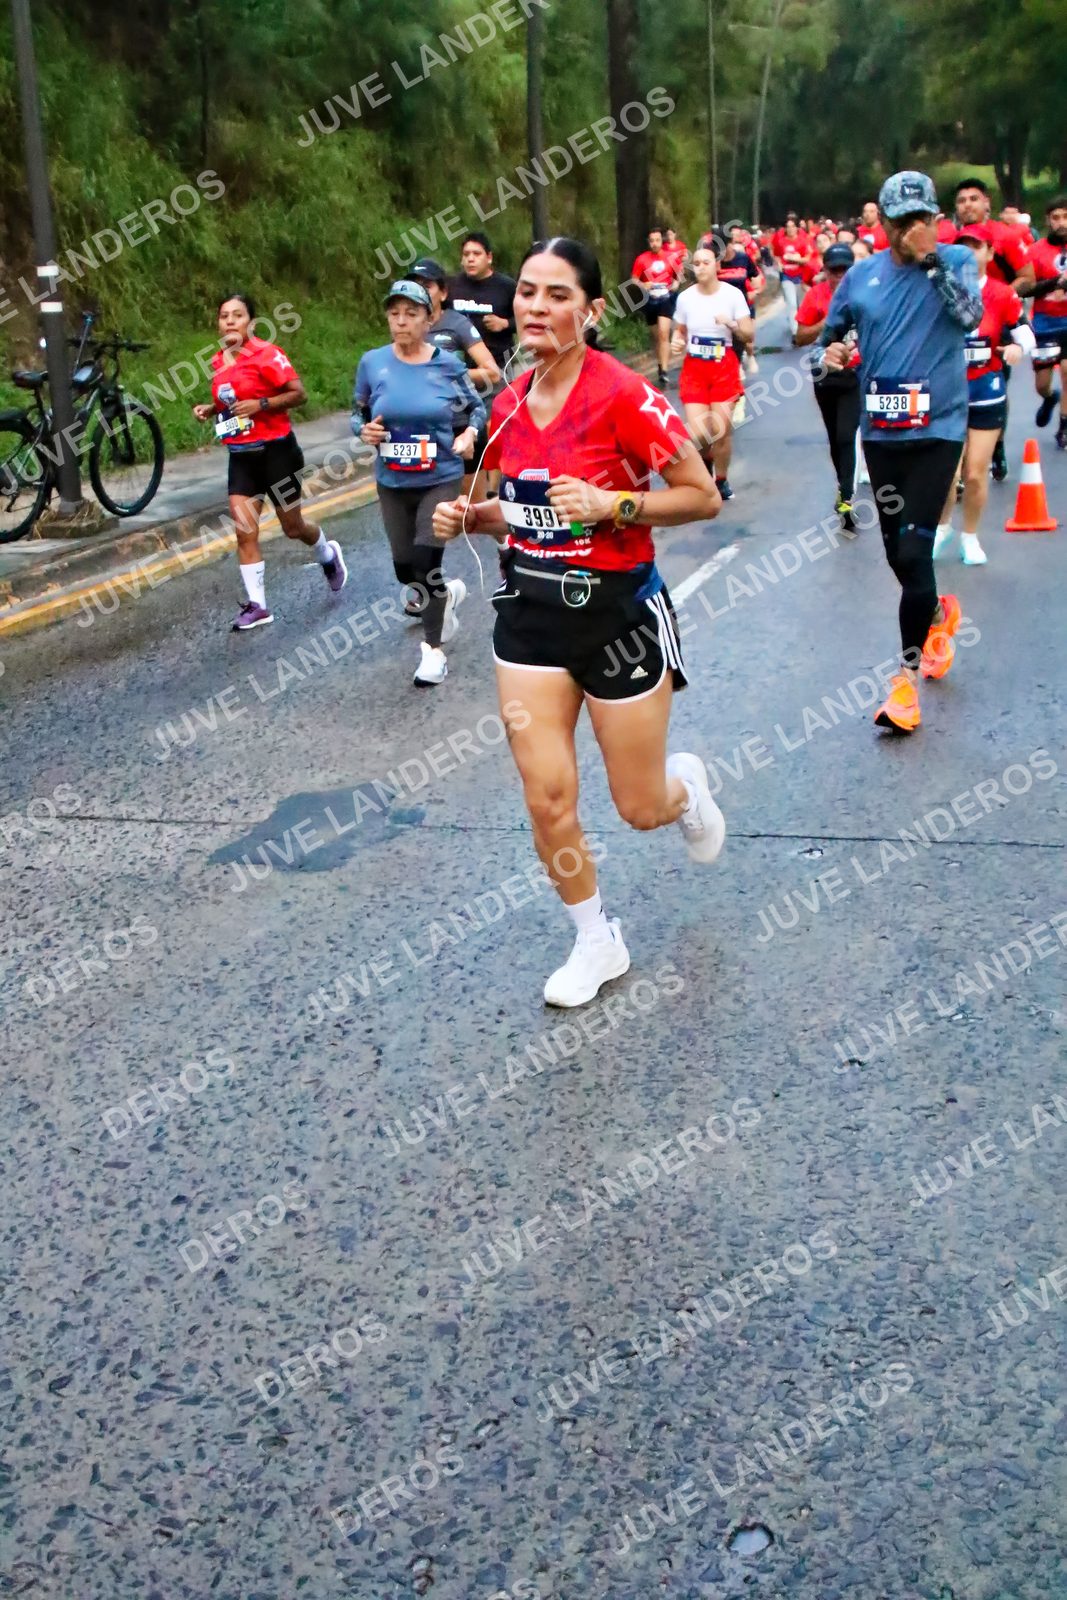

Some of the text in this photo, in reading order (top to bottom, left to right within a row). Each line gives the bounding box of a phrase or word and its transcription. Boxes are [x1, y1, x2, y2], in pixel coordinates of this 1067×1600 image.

[879, 396, 907, 410] 5238
[393, 444, 418, 456] 5237
[537, 531, 554, 539] 20-20
[574, 538, 592, 546] 10K
